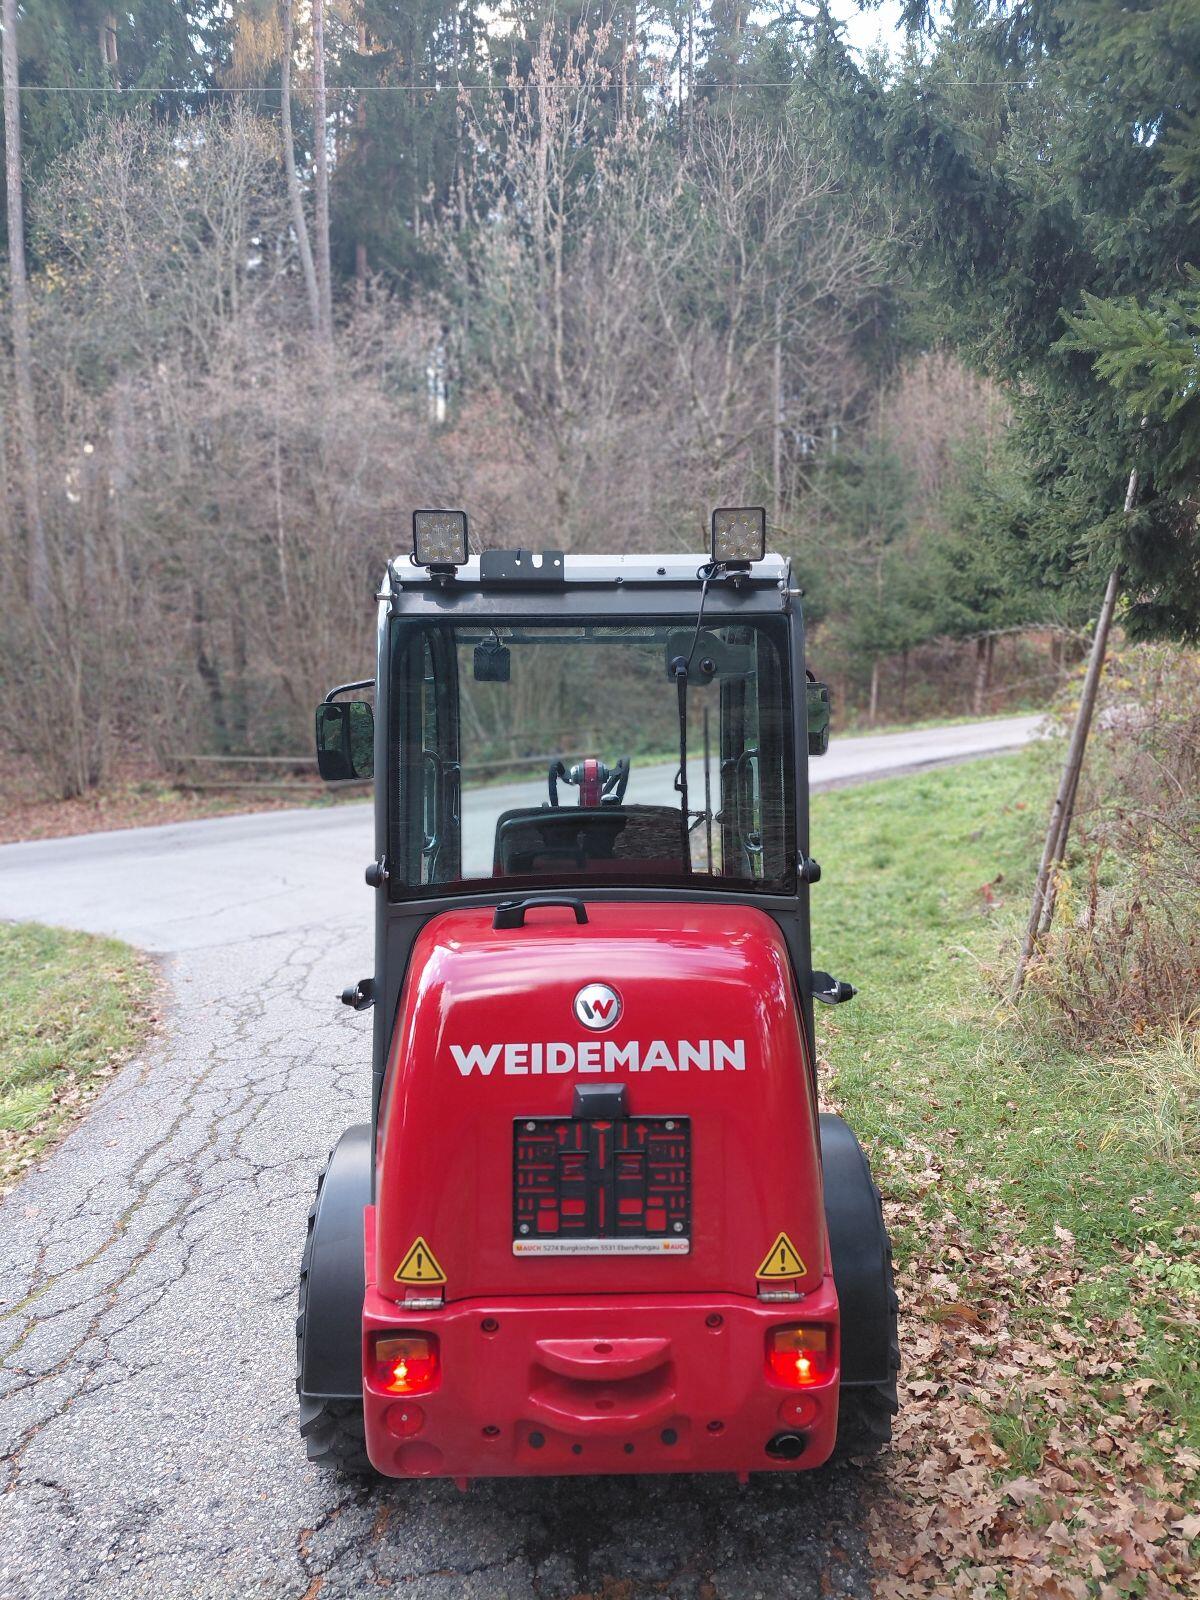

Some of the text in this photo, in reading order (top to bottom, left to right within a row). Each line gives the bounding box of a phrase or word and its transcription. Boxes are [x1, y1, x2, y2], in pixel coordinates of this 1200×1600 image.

[449, 1040, 746, 1076] WEIDEMANN
[543, 1244, 559, 1252] 5274
[560, 1243, 599, 1253] Burgkirchen
[601, 1243, 616, 1251] 5531
[617, 1242, 660, 1253] Eben/Pongau
